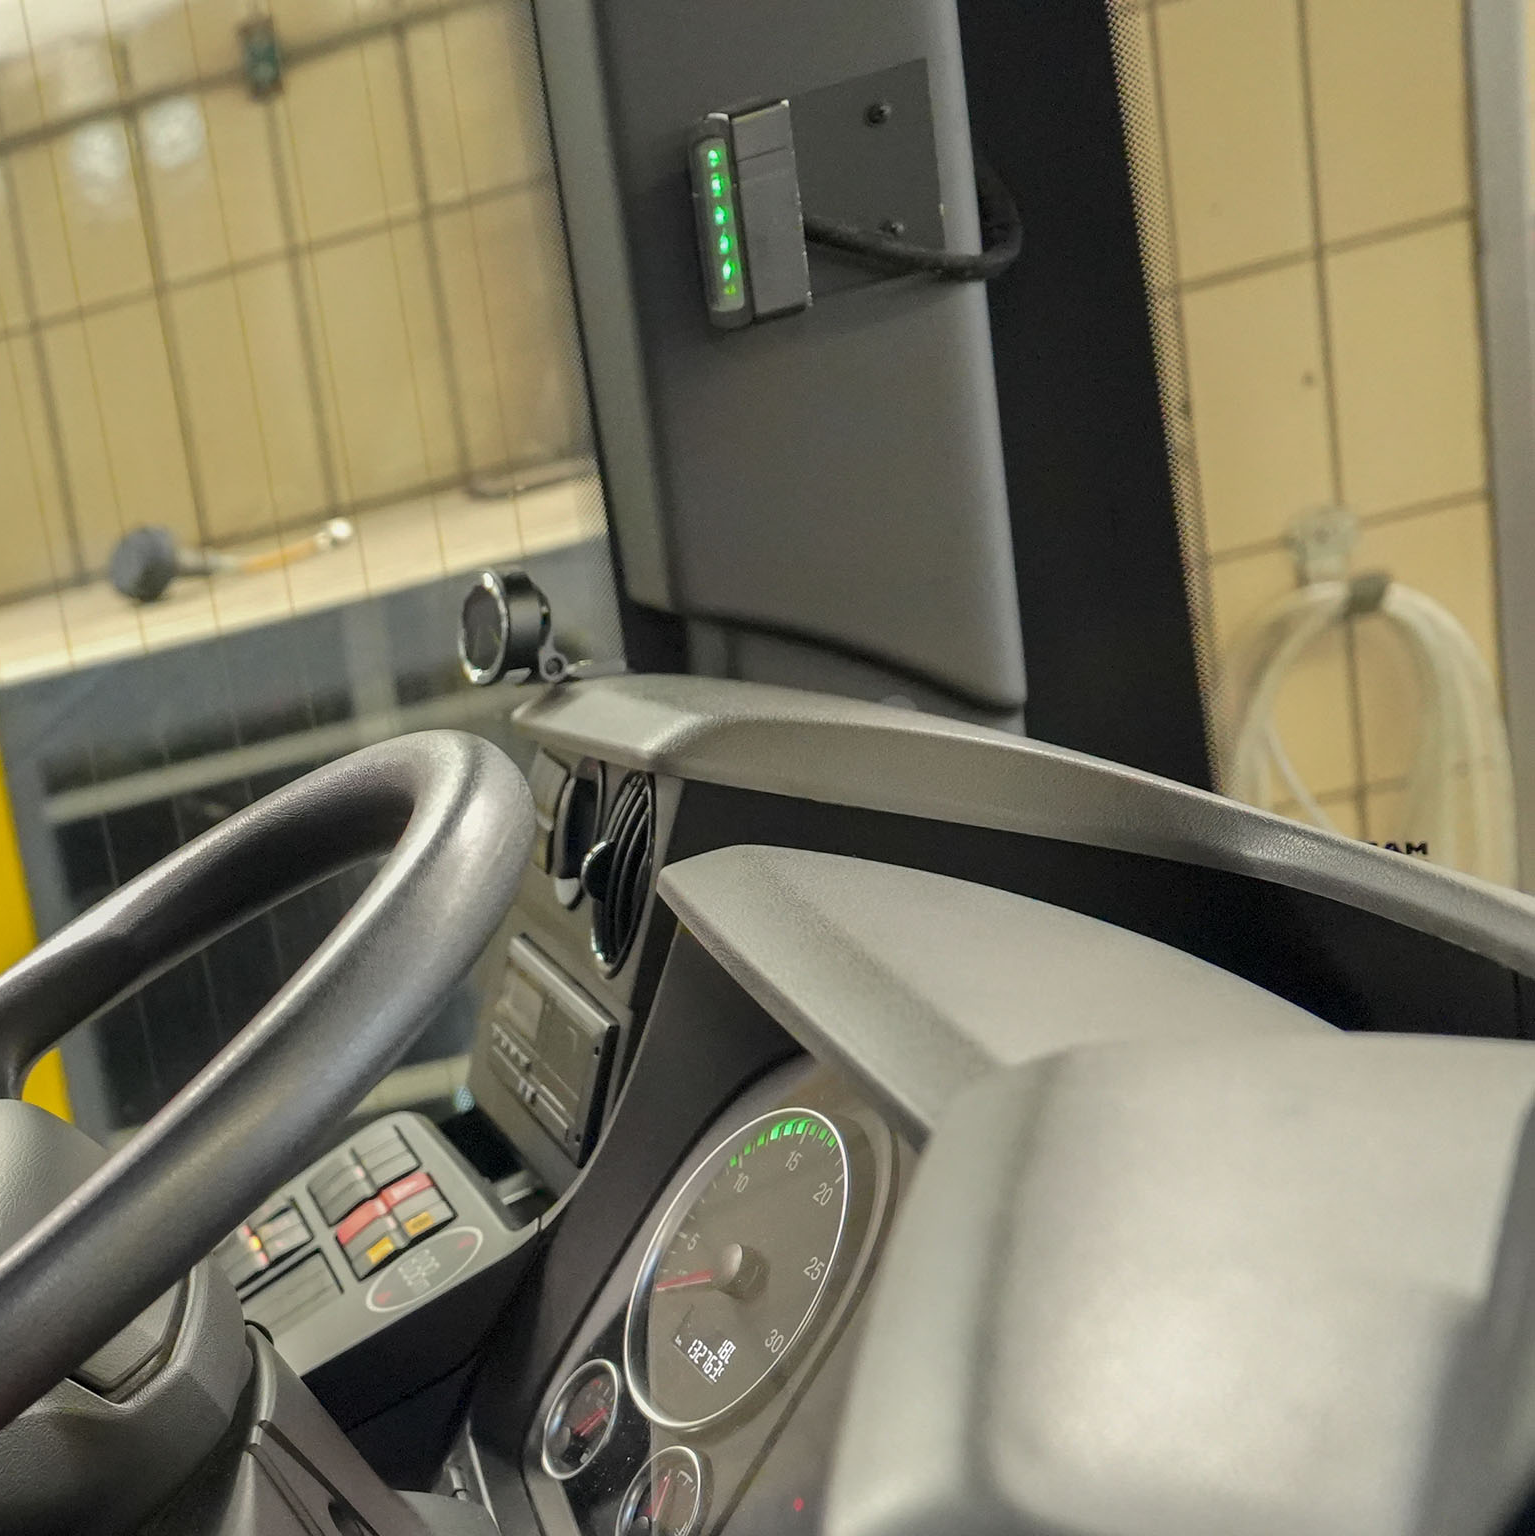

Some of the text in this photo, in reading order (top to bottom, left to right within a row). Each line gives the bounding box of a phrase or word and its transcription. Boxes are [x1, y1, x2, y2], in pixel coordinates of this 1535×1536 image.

[785, 1151, 803, 1172] 15
[733, 1172, 750, 1193] 10
[812, 1182, 834, 1206] 20
[803, 1256, 826, 1281] 25
[765, 1328, 785, 1354] 30
